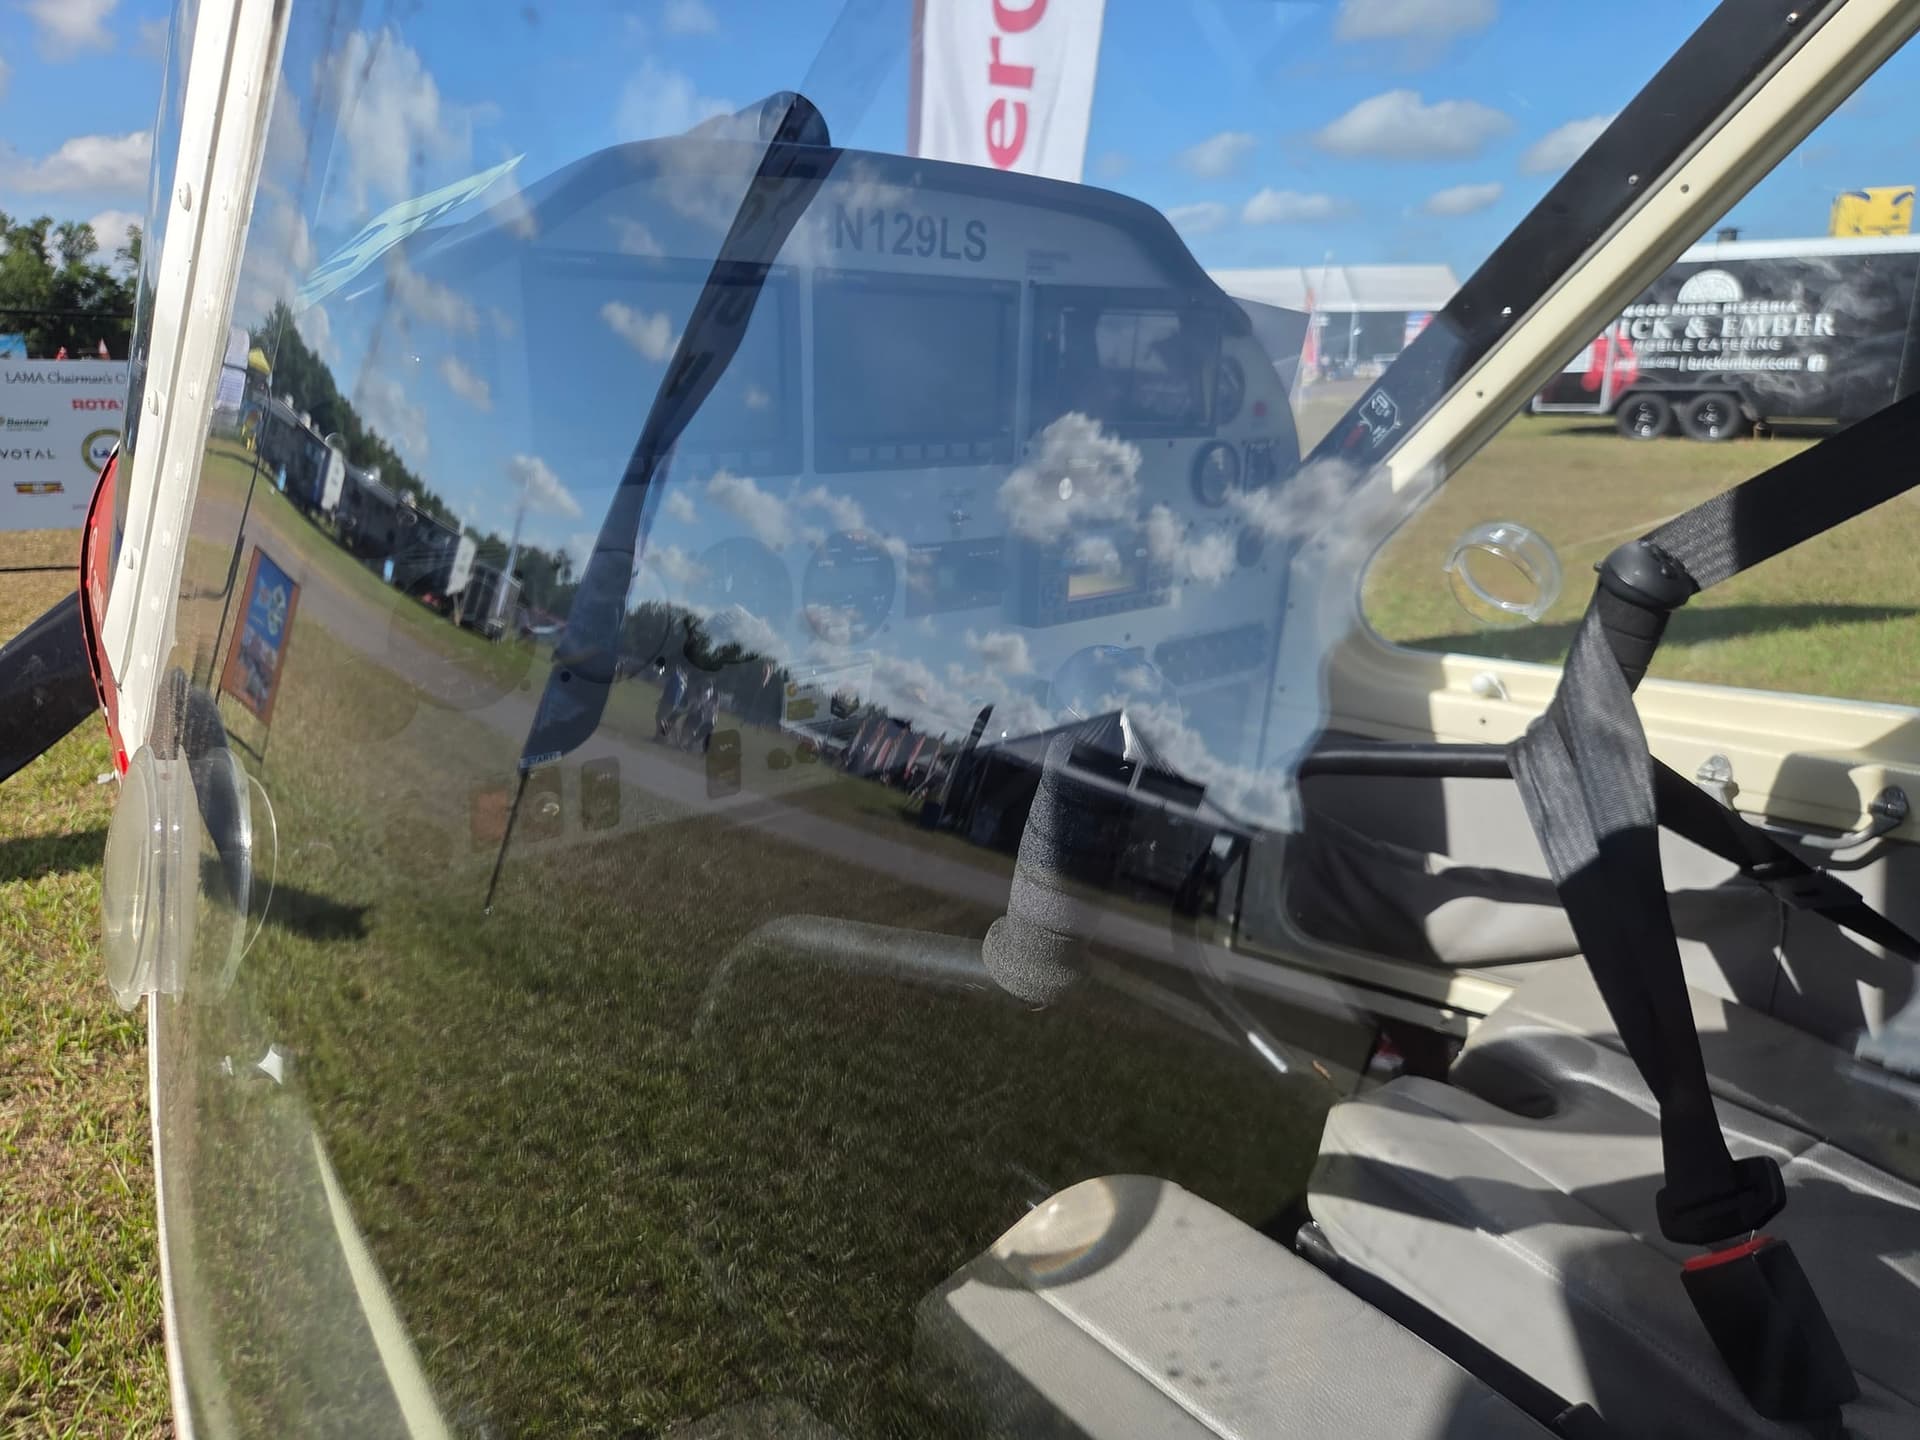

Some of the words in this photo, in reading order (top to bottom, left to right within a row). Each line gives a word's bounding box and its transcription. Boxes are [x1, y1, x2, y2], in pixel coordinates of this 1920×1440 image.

[834, 204, 988, 263] N129LS
[1684, 316, 1710, 338] &
[1721, 313, 1837, 337] EMBER
[1633, 339, 1693, 352] MOBILE
[1697, 337, 1783, 352] CATERING
[5, 371, 44, 385] LAMA
[71, 399, 123, 411] ROTA
